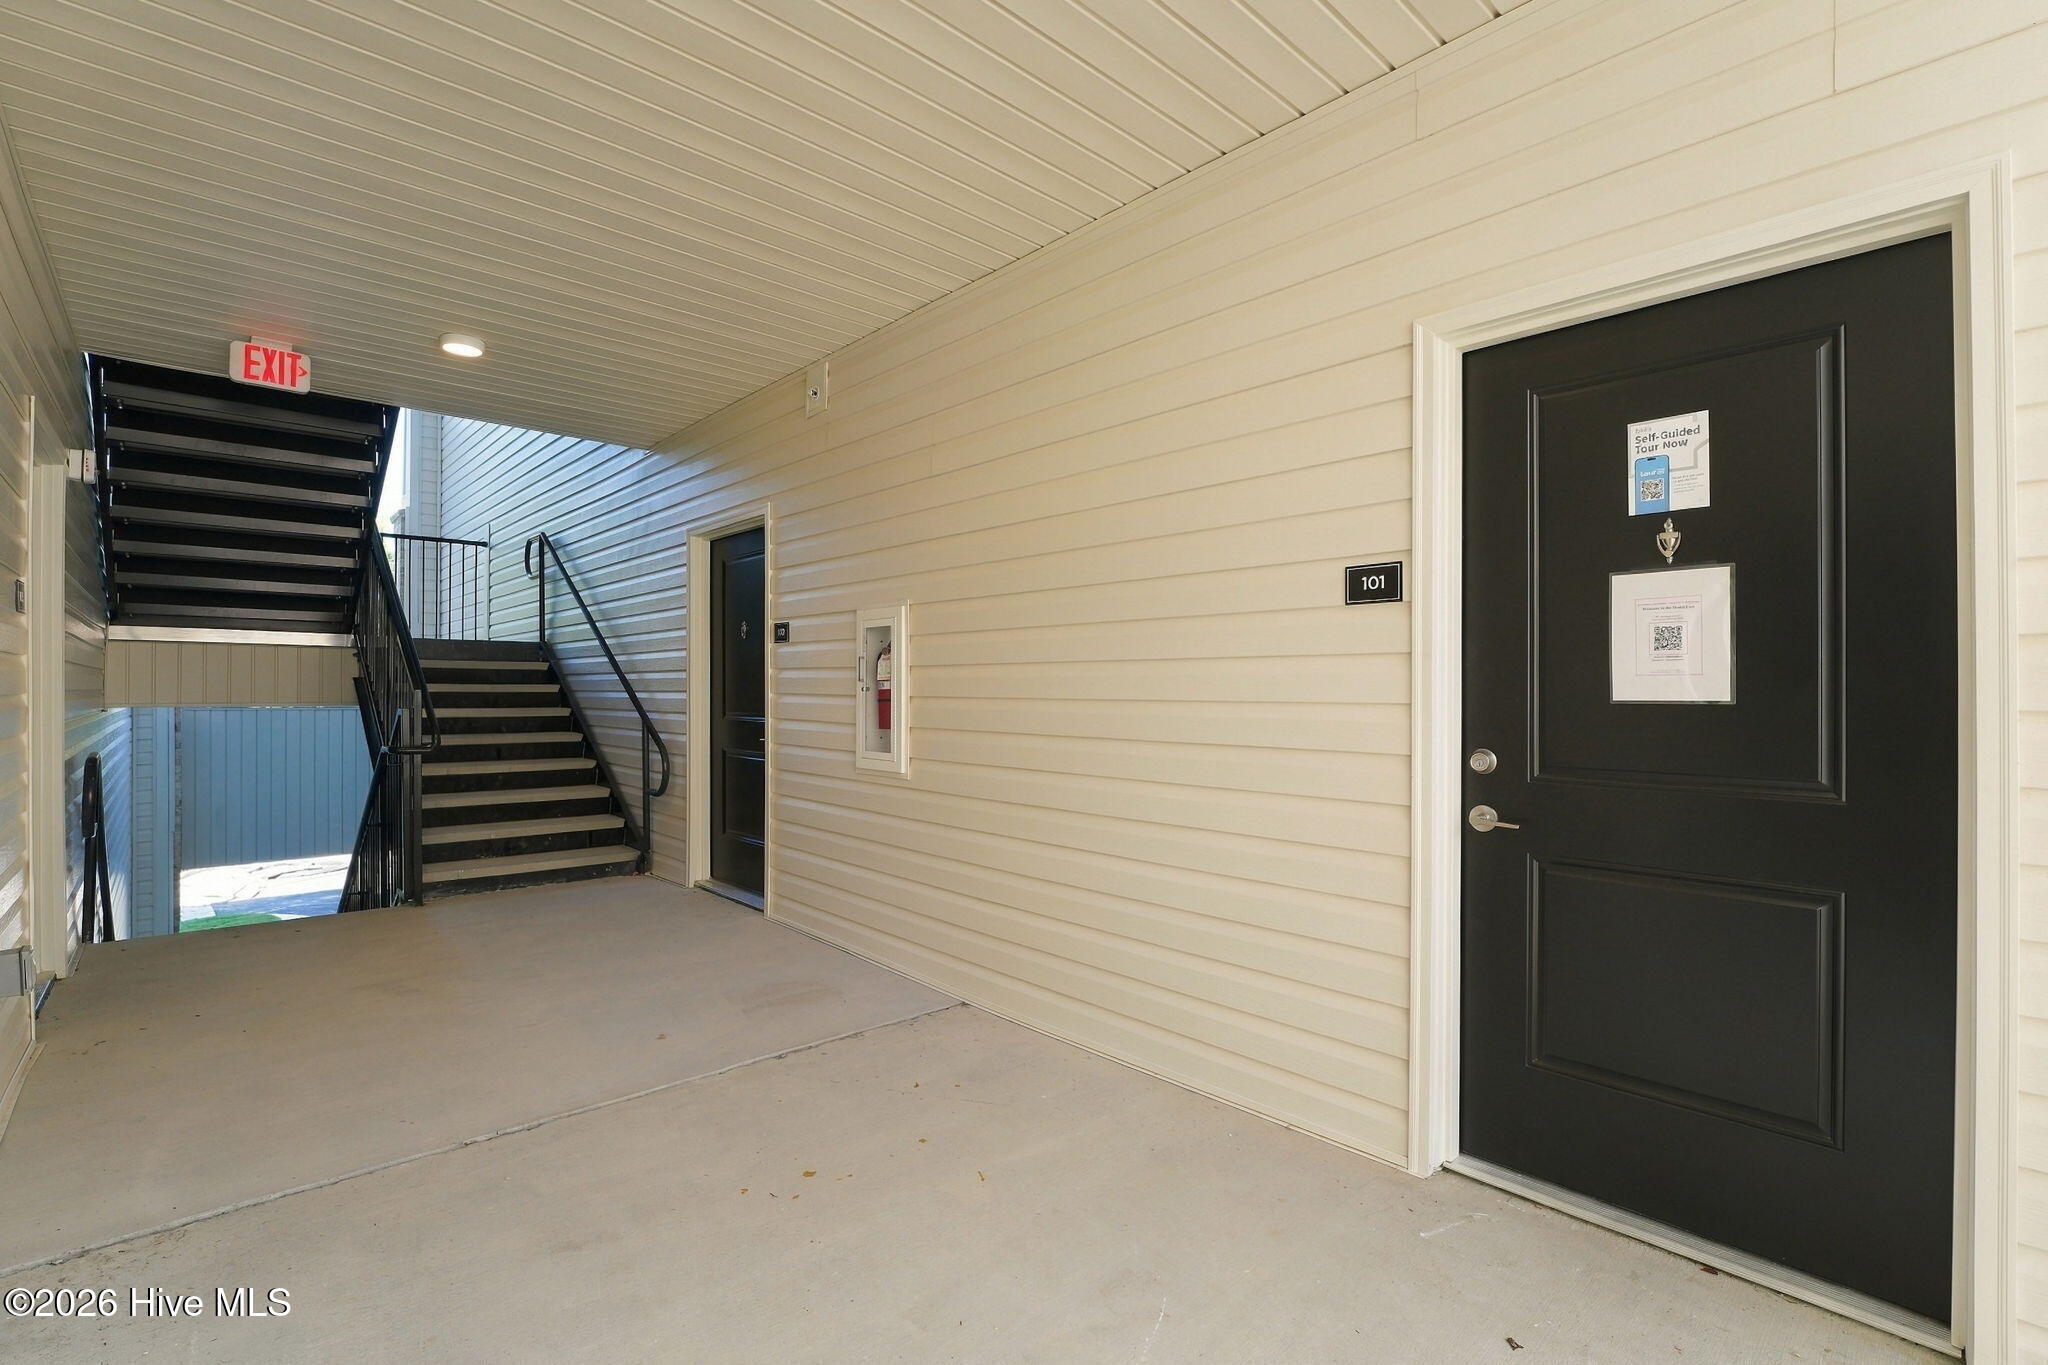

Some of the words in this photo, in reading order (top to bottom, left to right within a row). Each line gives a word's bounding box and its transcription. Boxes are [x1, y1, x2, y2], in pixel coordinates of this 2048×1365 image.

[244, 344, 301, 387] EXIT
[1635, 424, 1700, 444] Self-Guided
[1634, 444, 1659, 454] Tour
[1662, 439, 1688, 450] Now
[1361, 575, 1385, 590] 101
